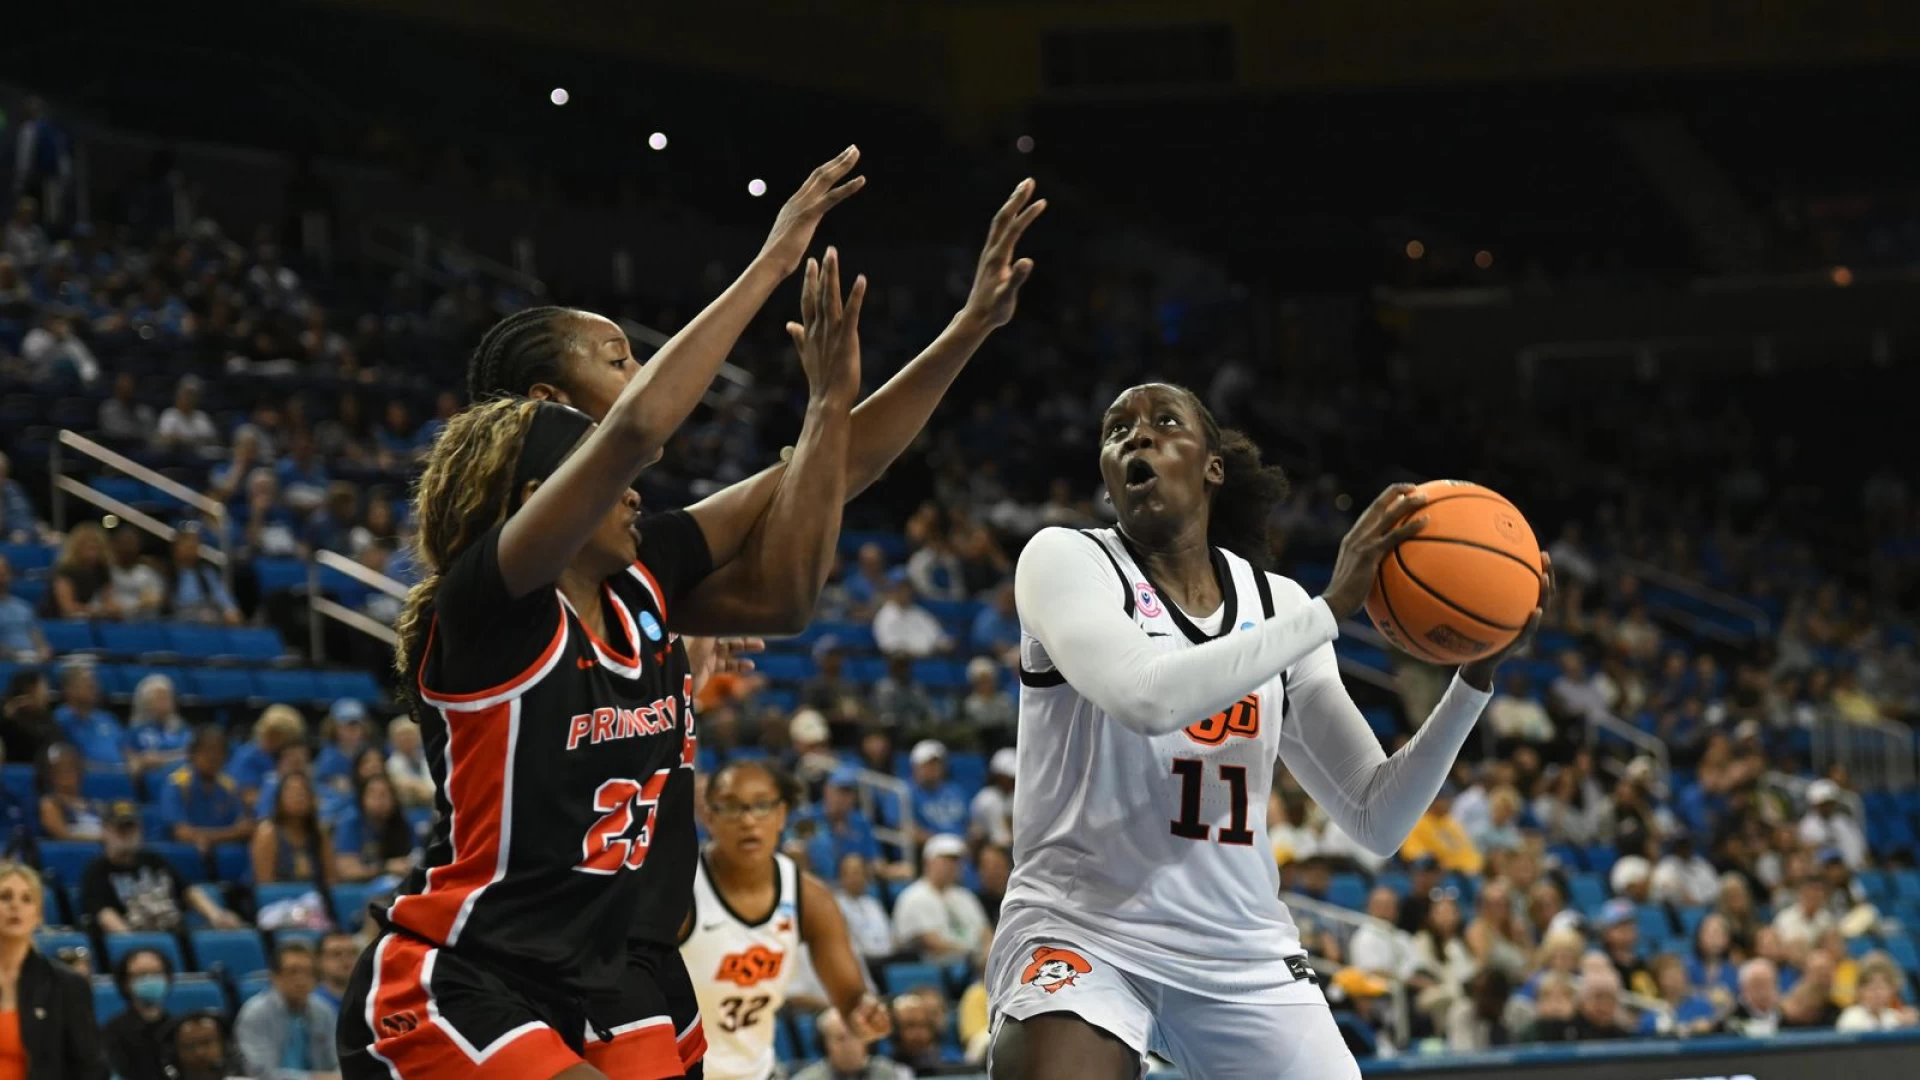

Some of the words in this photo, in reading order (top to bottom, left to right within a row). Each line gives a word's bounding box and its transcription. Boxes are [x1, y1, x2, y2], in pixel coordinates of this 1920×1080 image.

[572, 768, 671, 876] 23
[1170, 757, 1254, 846] 11
[718, 995, 770, 1033] 32
